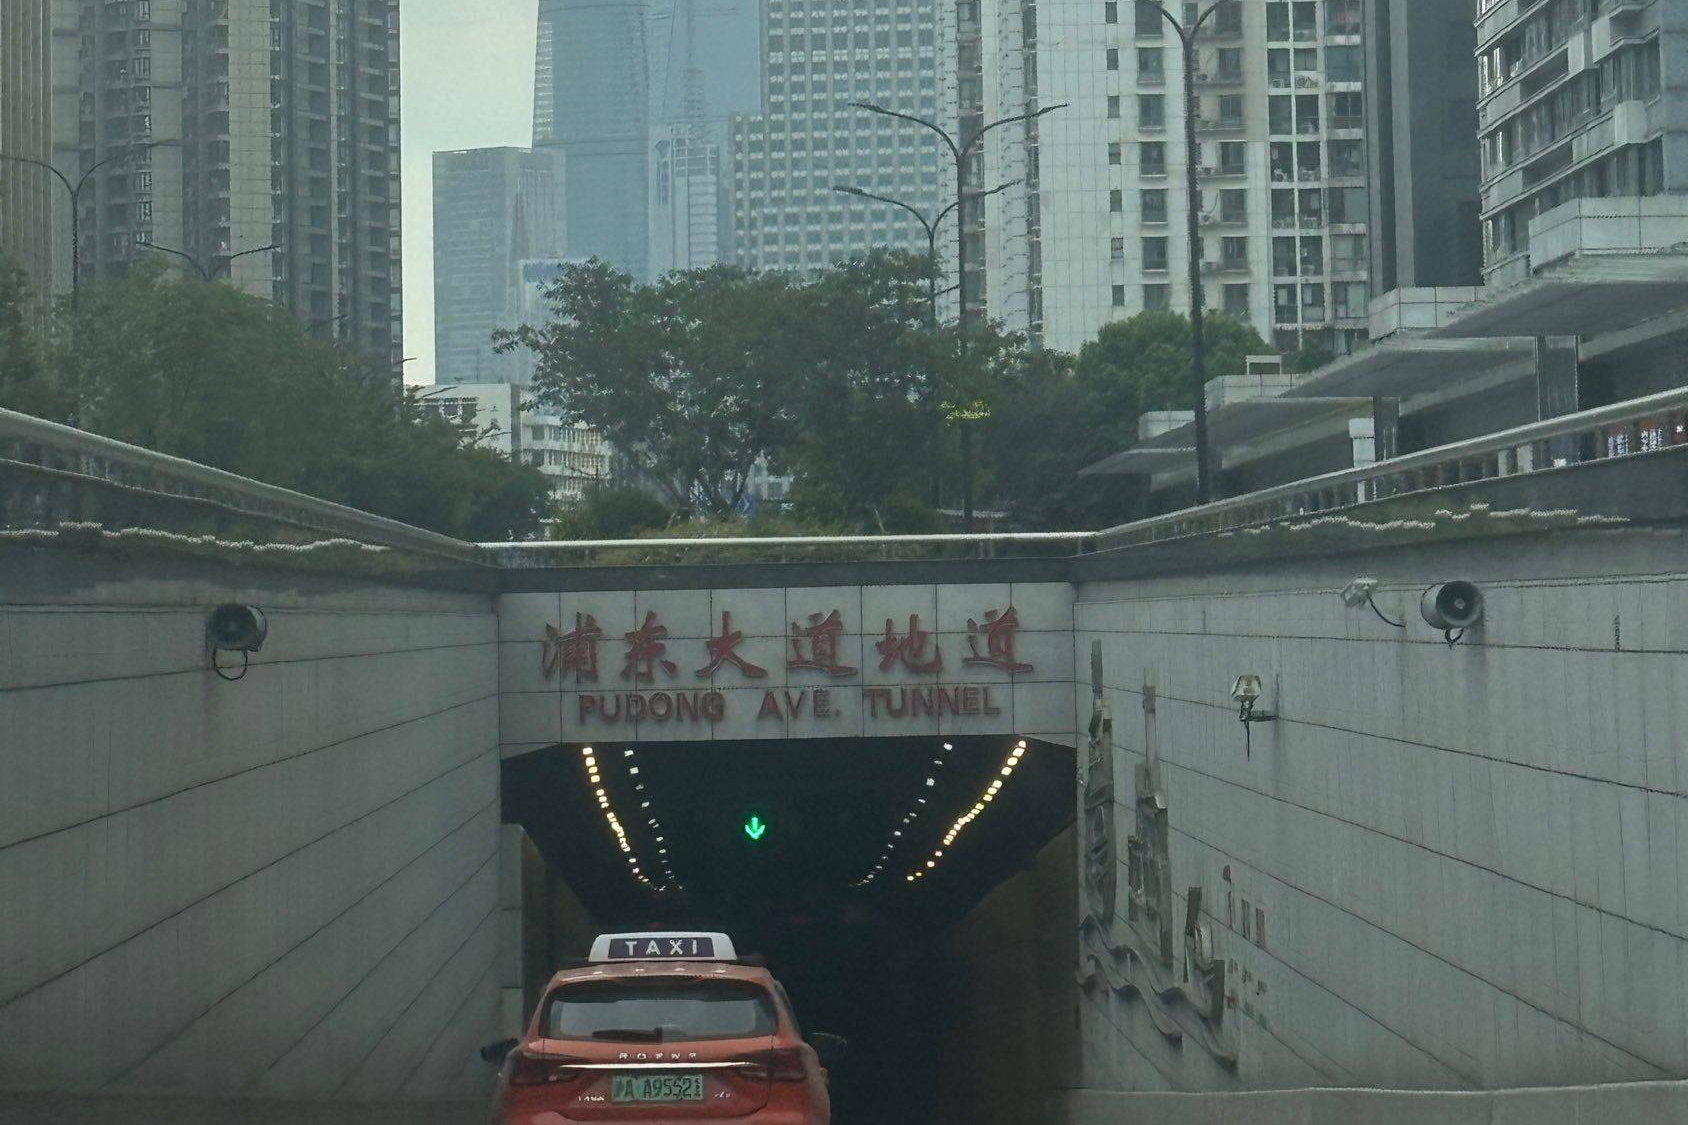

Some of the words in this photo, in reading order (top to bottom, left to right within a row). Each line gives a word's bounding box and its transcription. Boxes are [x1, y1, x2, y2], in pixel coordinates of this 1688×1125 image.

[542, 606, 1035, 682] 浦东大道地道
[578, 689, 726, 724] PUDONG
[756, 687, 843, 723] AVE.
[863, 685, 1003, 719] TUNNEL
[624, 938, 699, 957] TAXI
